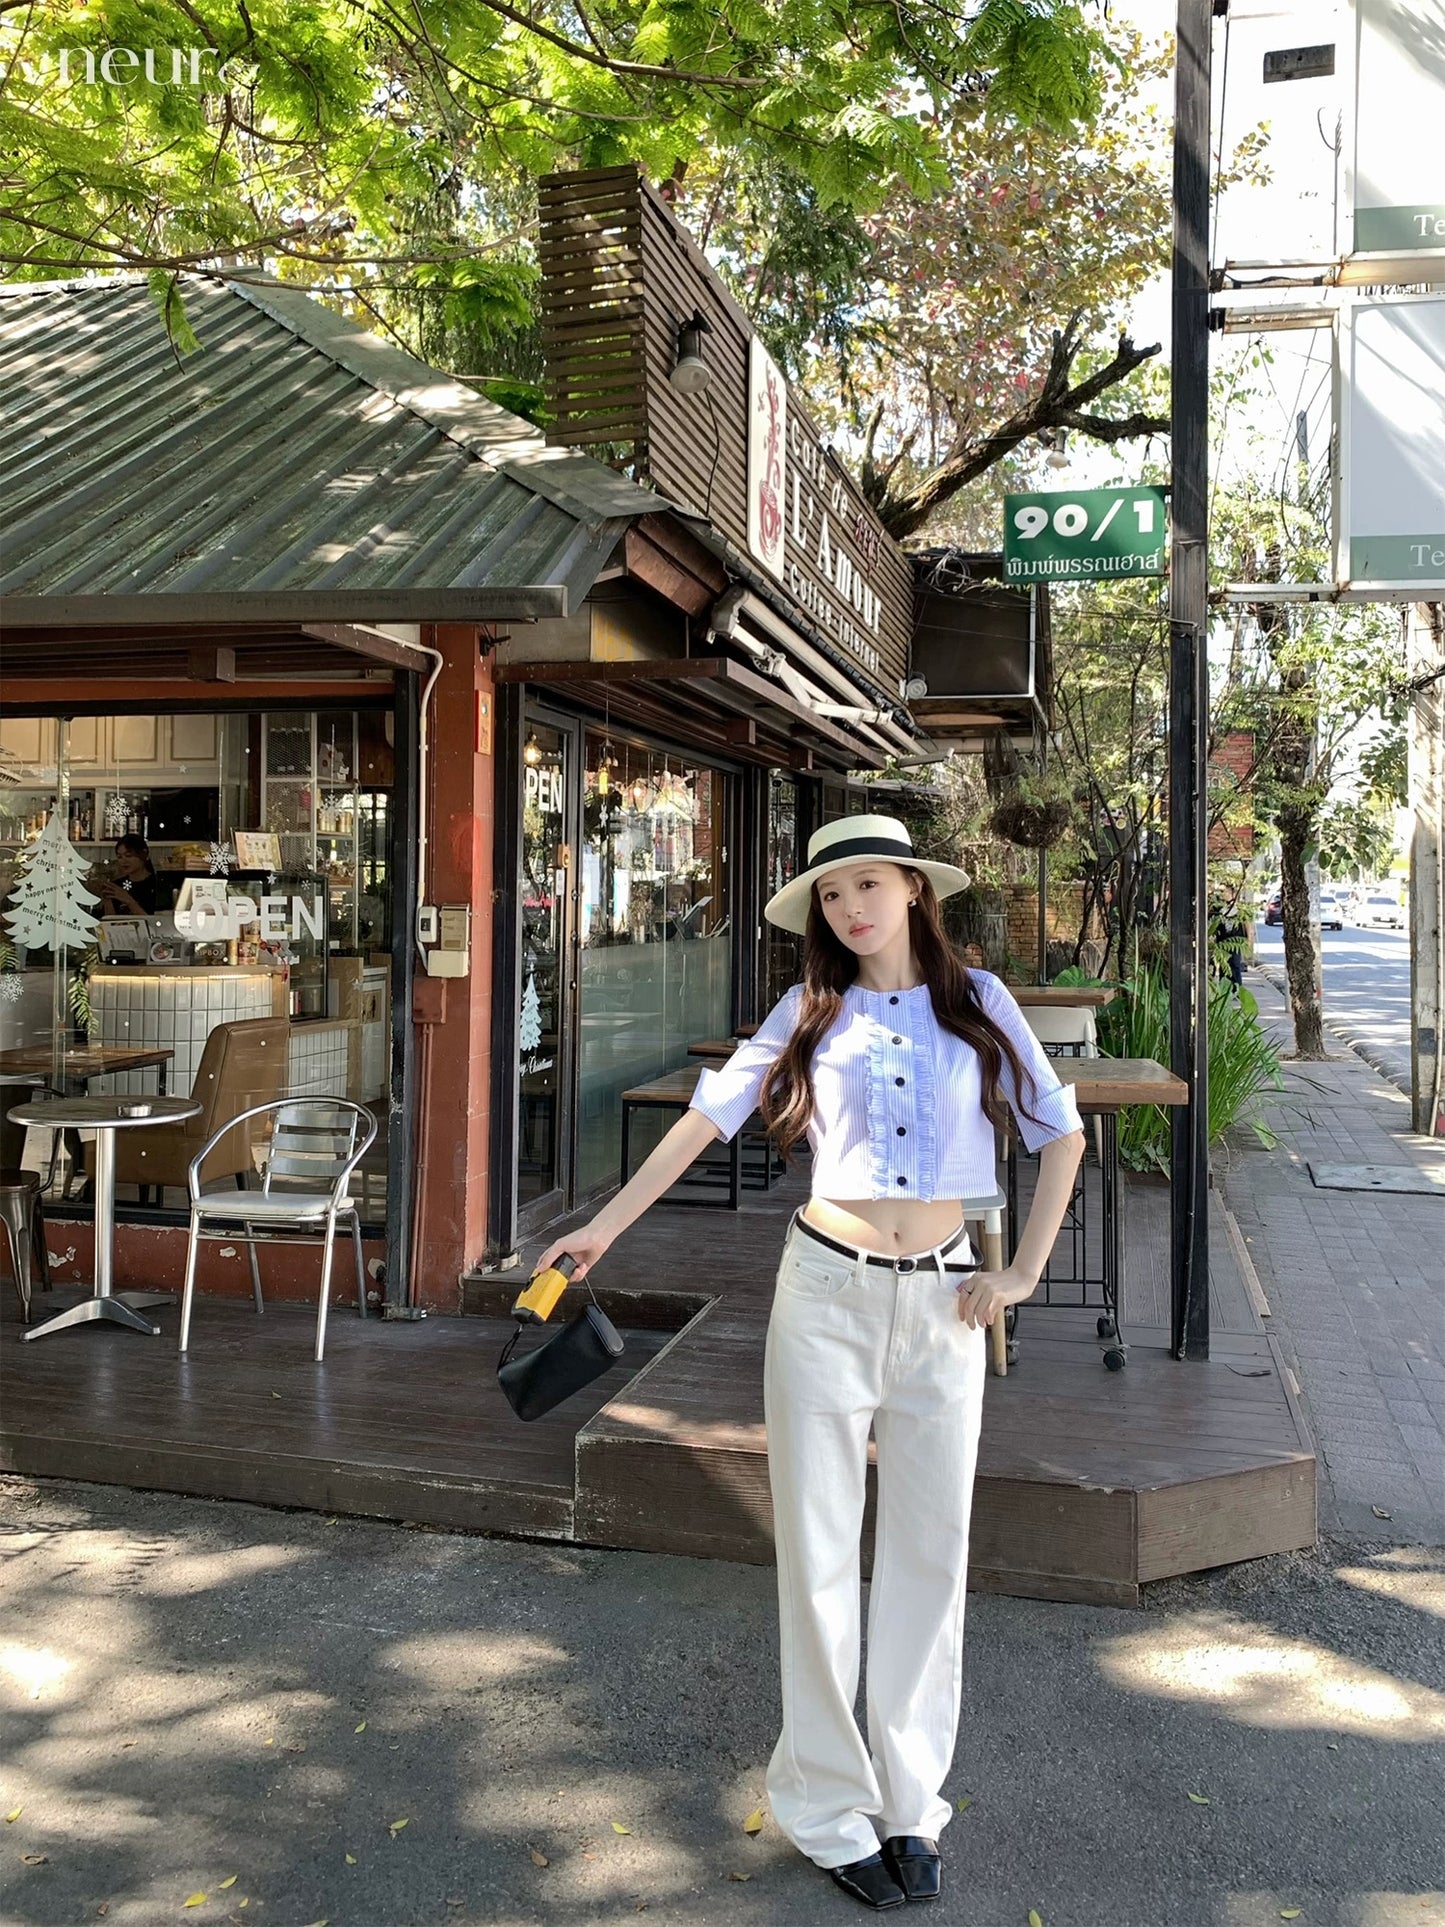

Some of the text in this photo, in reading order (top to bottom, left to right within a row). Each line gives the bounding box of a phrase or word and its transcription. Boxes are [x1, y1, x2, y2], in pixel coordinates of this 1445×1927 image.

[832, 479, 848, 519] de
[1014, 499, 1154, 542] 90/1
[1007, 548, 1160, 577] พิมพ์พรรณเฮาส์
[1410, 544, 1445, 567] Te
[523, 766, 563, 814] PEN
[36, 858, 73, 875] christs
[25, 889, 45, 899] happy
[22, 906, 82, 931] merry chrstmas
[189, 895, 323, 942] OPEN
